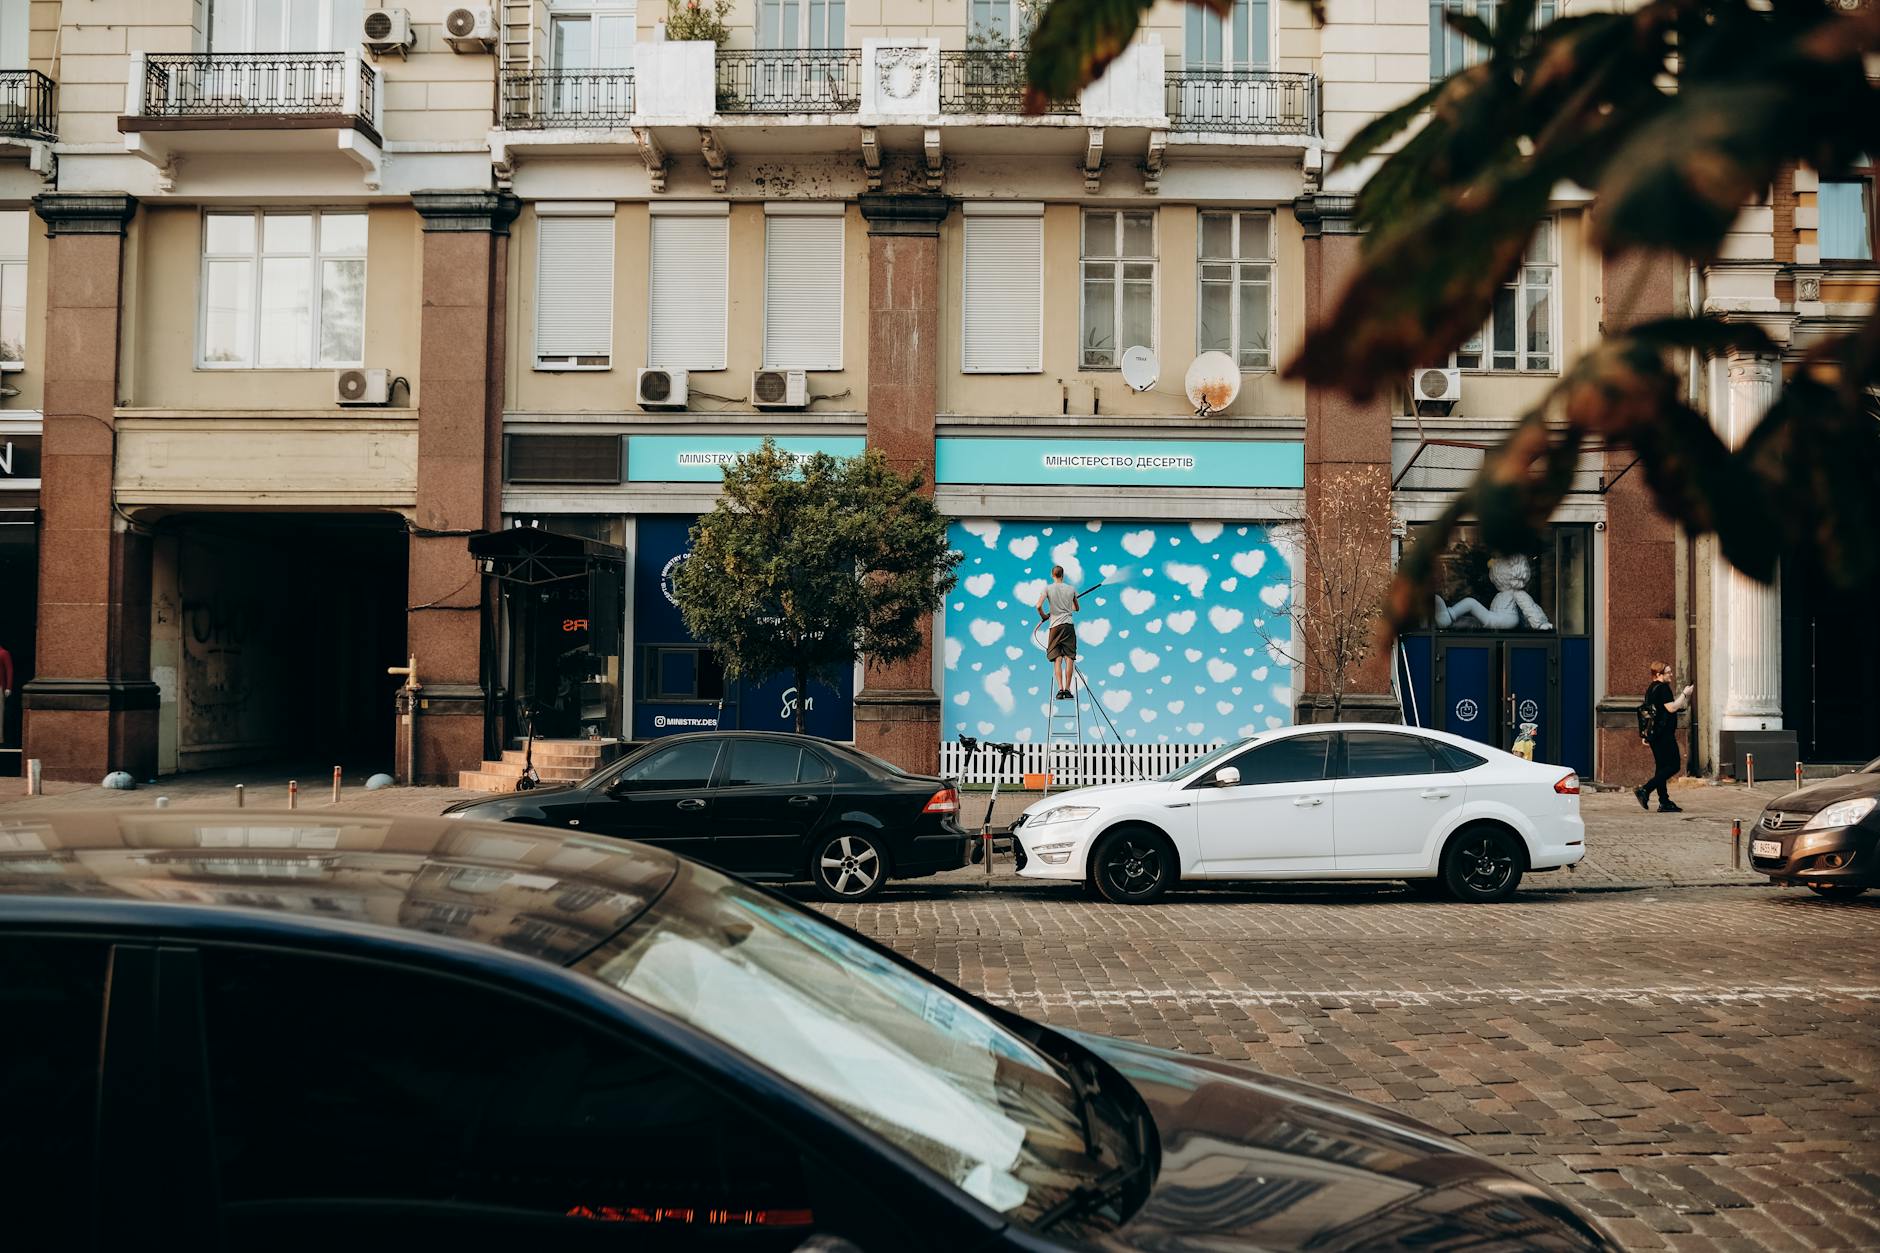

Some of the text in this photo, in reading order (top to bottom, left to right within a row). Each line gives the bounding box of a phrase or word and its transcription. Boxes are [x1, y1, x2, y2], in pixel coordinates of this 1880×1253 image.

[679, 454, 733, 464] MINISTRY
[1046, 456, 1193, 468] МІНІСТЕРСТВО ДЕСЕРТІВ
[666, 718, 717, 726] MINISTRY.DES
